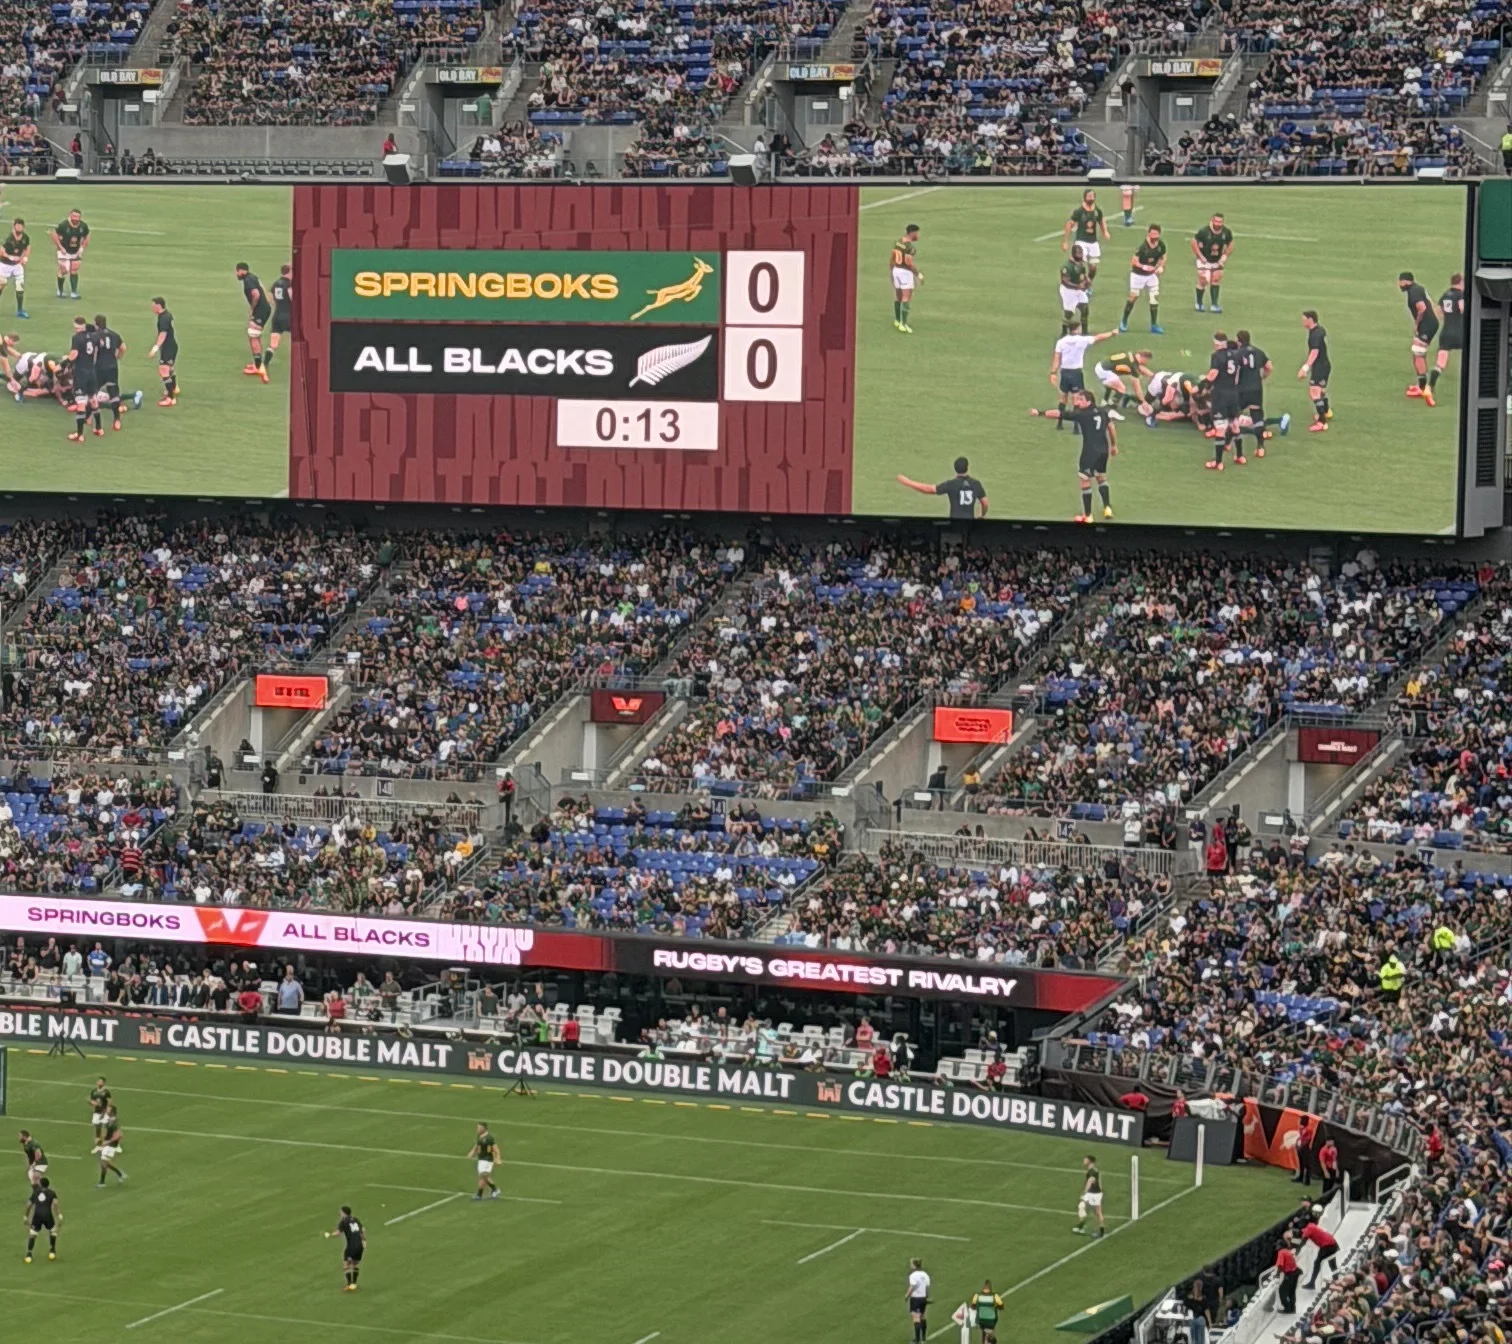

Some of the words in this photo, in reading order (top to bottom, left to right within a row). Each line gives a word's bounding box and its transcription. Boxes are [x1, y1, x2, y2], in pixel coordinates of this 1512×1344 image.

[354, 271, 618, 300] SPRINGBOKS
[748, 261, 779, 313] 0
[353, 346, 433, 373] ALL
[443, 347, 614, 376] BLACKS
[746, 338, 778, 389] 0
[595, 407, 681, 443] 0:13
[1092, 415, 1101, 430] 7
[959, 489, 974, 505] 13
[27, 907, 181, 930] SPRINGBOKS
[282, 922, 328, 941] ALL
[334, 926, 431, 947] BLACKS
[653, 949, 764, 975] RUGBY'S
[767, 958, 903, 987] GREATEST
[908, 970, 1018, 997] RIVALRY
[167, 1024, 260, 1054] CASTLE
[267, 1031, 371, 1061] DOUBLE
[377, 1039, 453, 1068] MALT
[497, 1049, 596, 1081] CASTLE
[602, 1059, 711, 1090] DOUBLE
[717, 1067, 795, 1097] MALT
[847, 1080, 945, 1115] CASTLE
[952, 1092, 1056, 1127] DOUBLE
[1061, 1104, 1136, 1141] MALT
